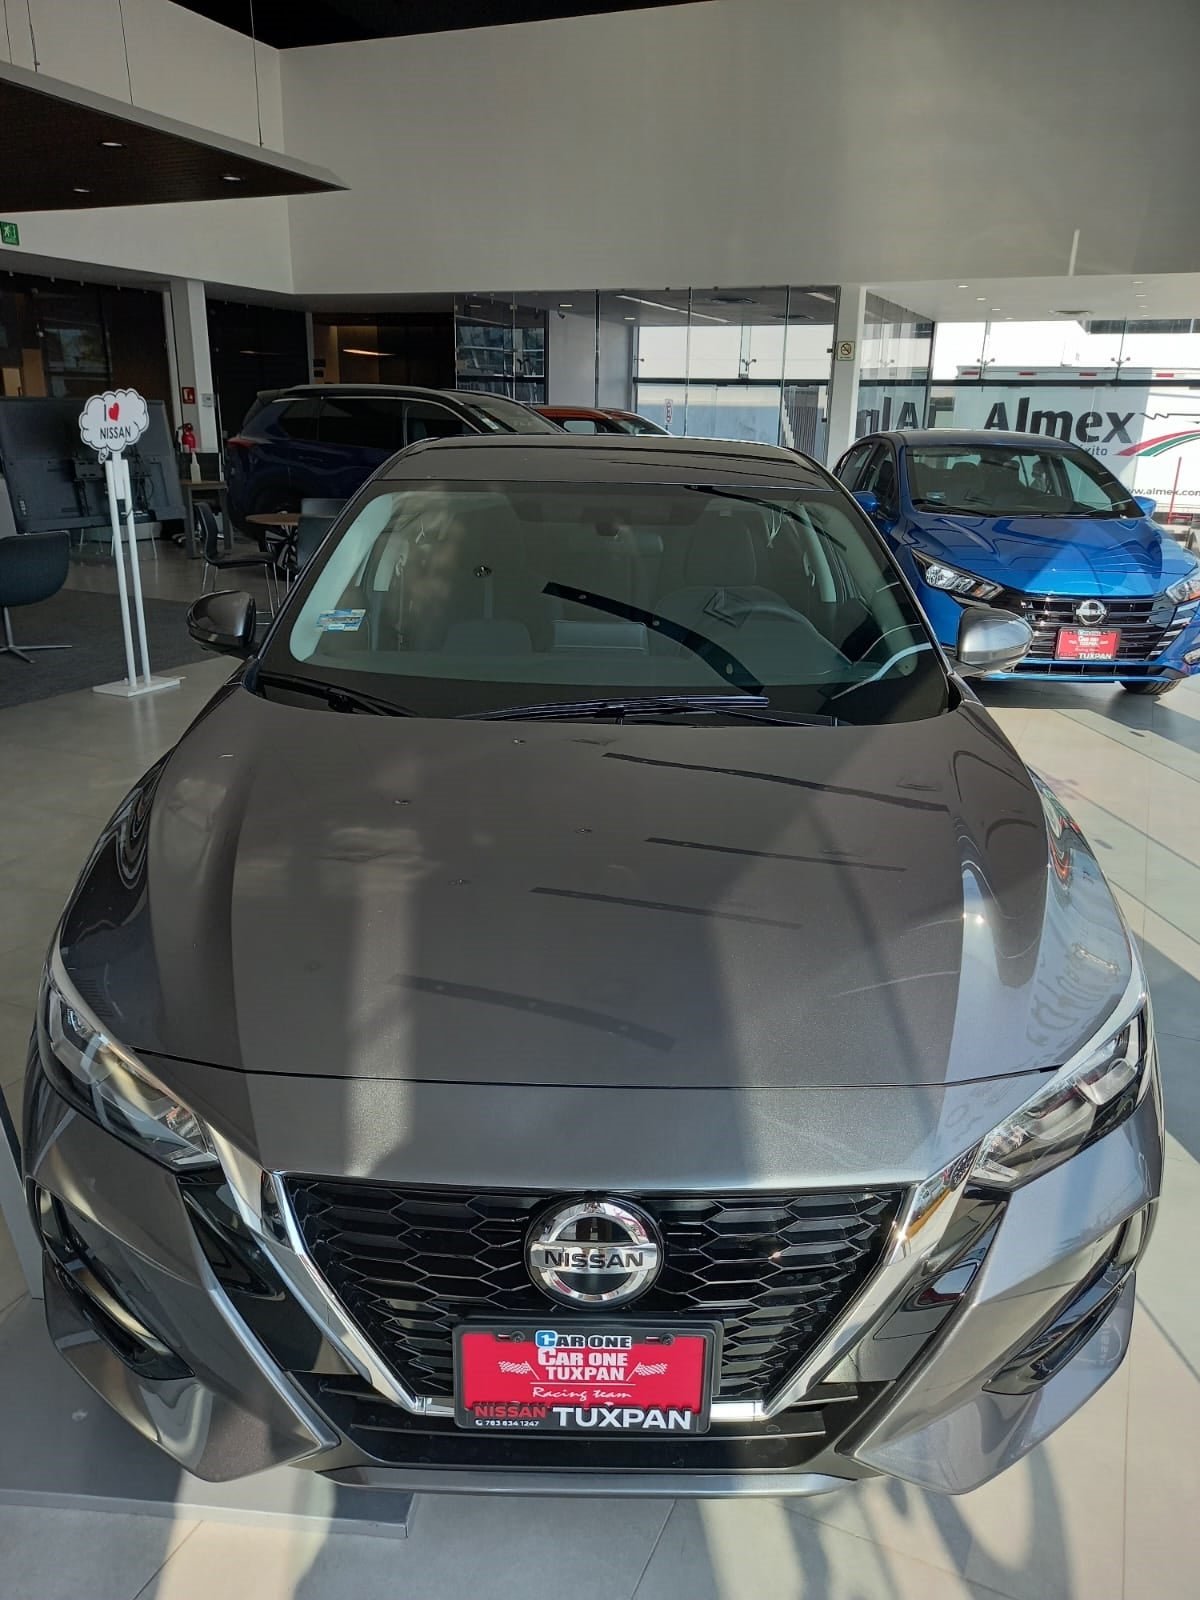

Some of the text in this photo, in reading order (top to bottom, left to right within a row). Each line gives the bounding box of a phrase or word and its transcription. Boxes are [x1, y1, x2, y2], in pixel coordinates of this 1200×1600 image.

[984, 397, 1135, 443] Almex
[100, 426, 131, 440] NISSAN
[544, 1250, 643, 1269] NISSAN
[535, 1330, 633, 1349] CAR ONE
[538, 1348, 628, 1367] CAR ONE
[545, 1366, 625, 1381] TUXPAN
[532, 1387, 632, 1402] Racing team
[474, 1405, 692, 1430] NISSAN TUXPAN
